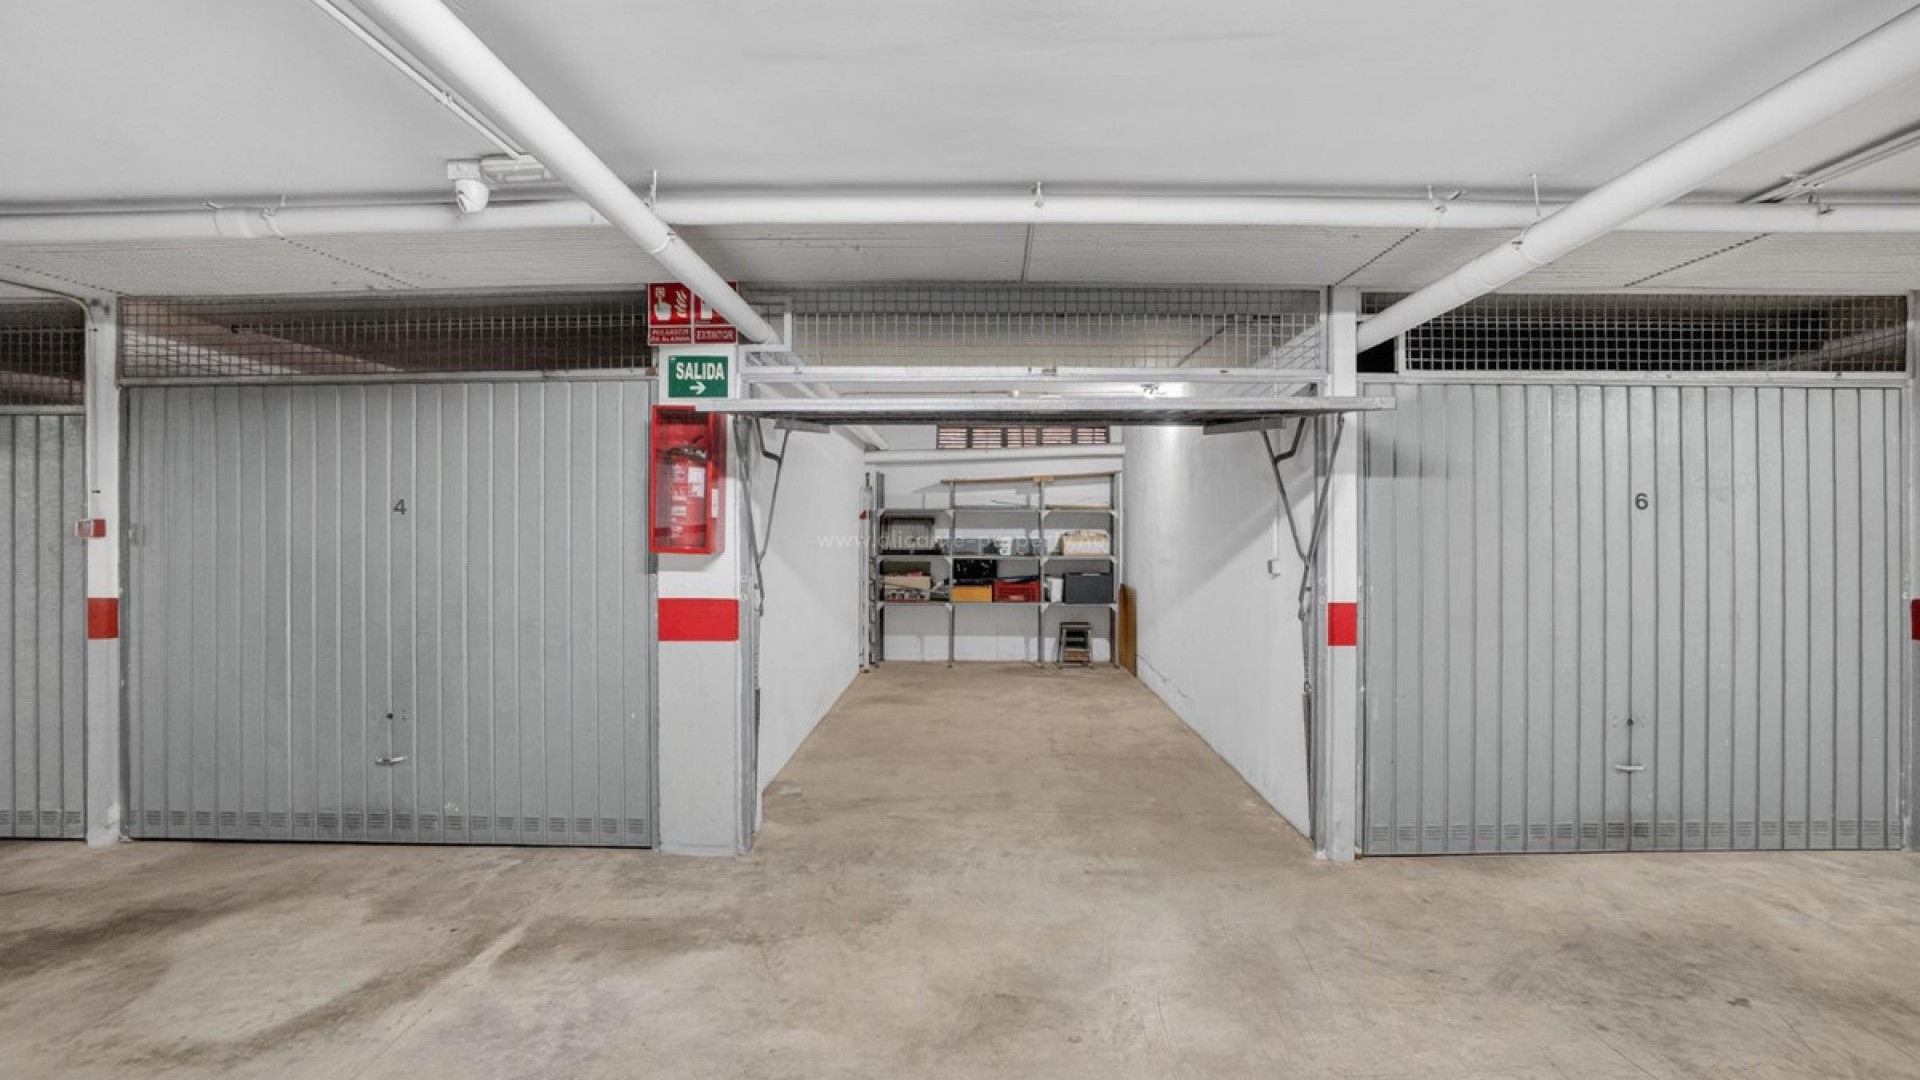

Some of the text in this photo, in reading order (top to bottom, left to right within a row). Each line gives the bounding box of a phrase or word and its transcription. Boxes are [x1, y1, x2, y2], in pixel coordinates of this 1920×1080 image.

[676, 362, 725, 380] SALIDA
[394, 498, 406, 516] 4
[1635, 493, 1648, 510] 6
